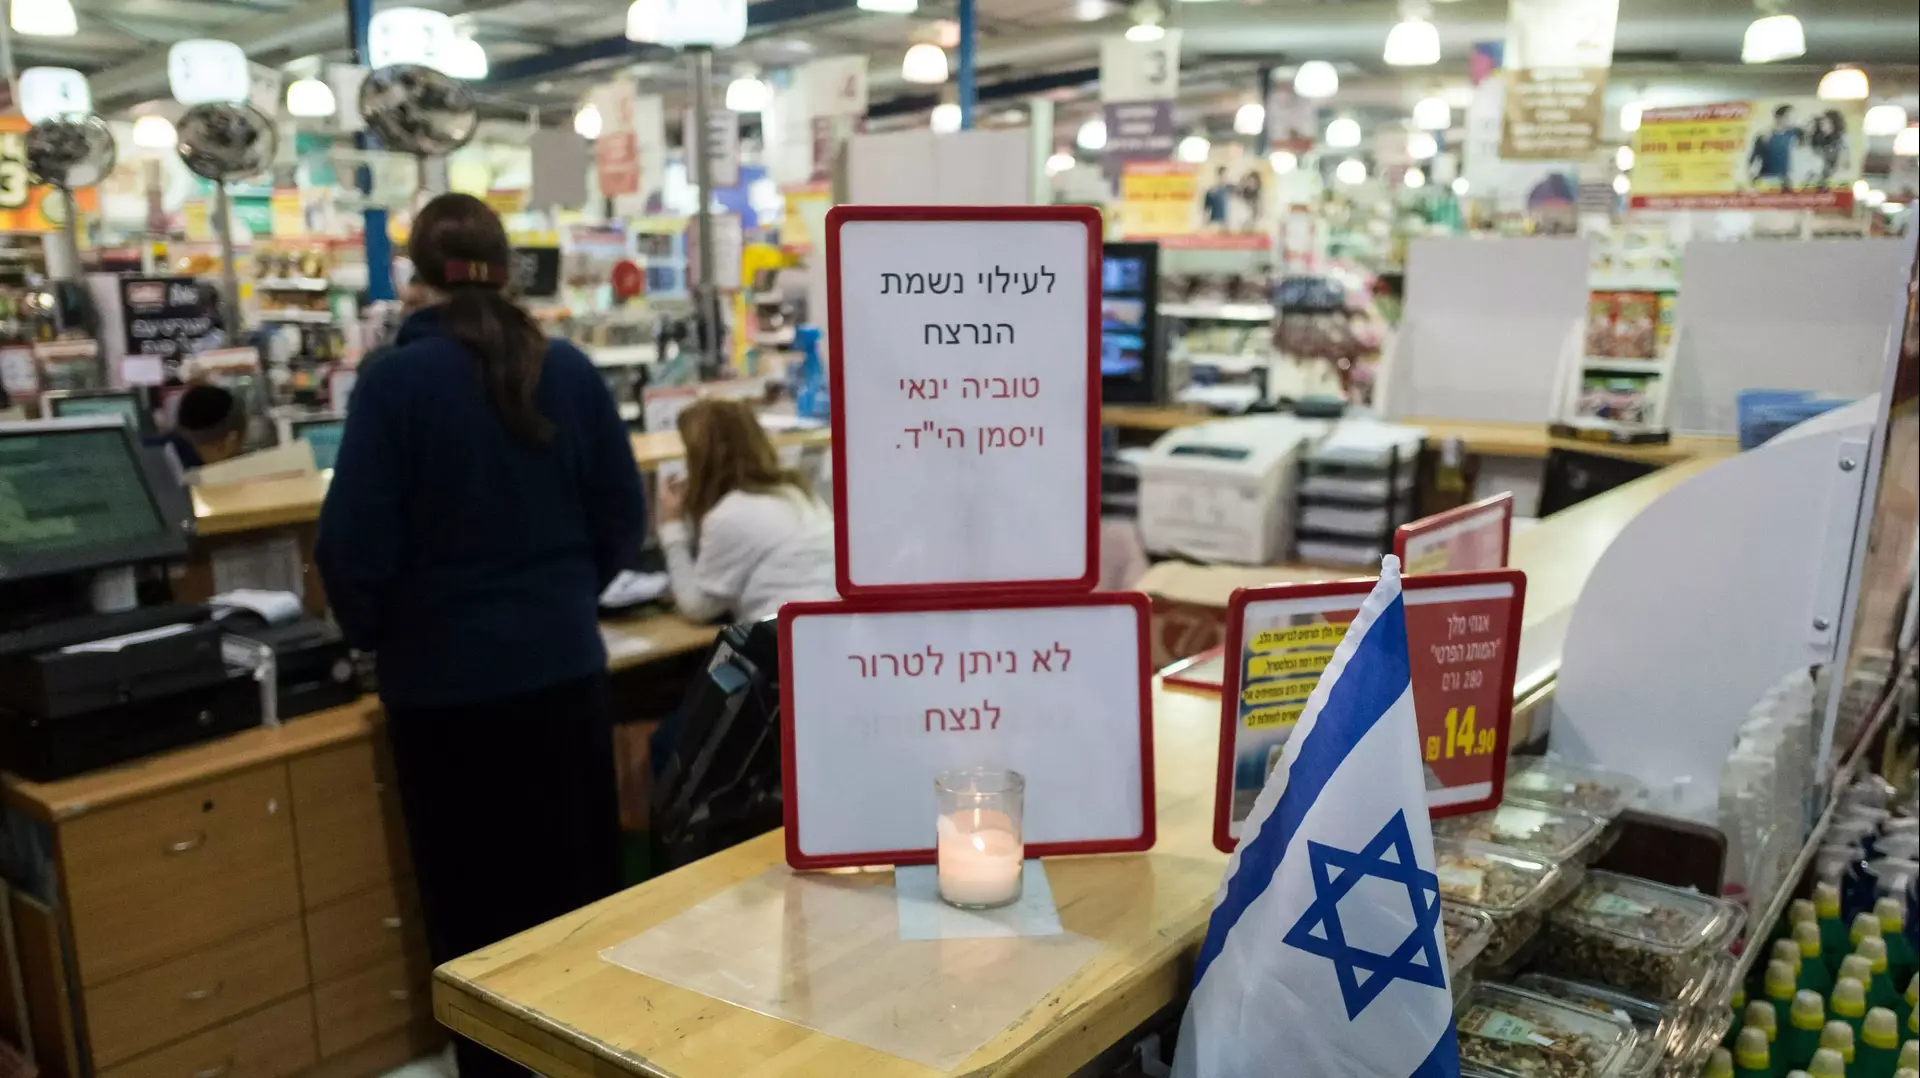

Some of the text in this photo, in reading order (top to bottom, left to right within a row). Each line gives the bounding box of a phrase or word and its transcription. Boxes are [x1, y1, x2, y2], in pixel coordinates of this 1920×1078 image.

[880, 265, 1056, 295] לעילוי נשמת
[924, 323, 1015, 345] הנרצח
[900, 376, 1040, 400] טוביה ינאי
[979, 426, 1044, 455] ויסמן
[1447, 612, 1466, 641] מלך
[848, 642, 1072, 683] לא ניתן לטרור
[1442, 671, 1461, 692] גרם
[924, 699, 1001, 733] לנצח
[1444, 705, 1496, 760] 14.90
